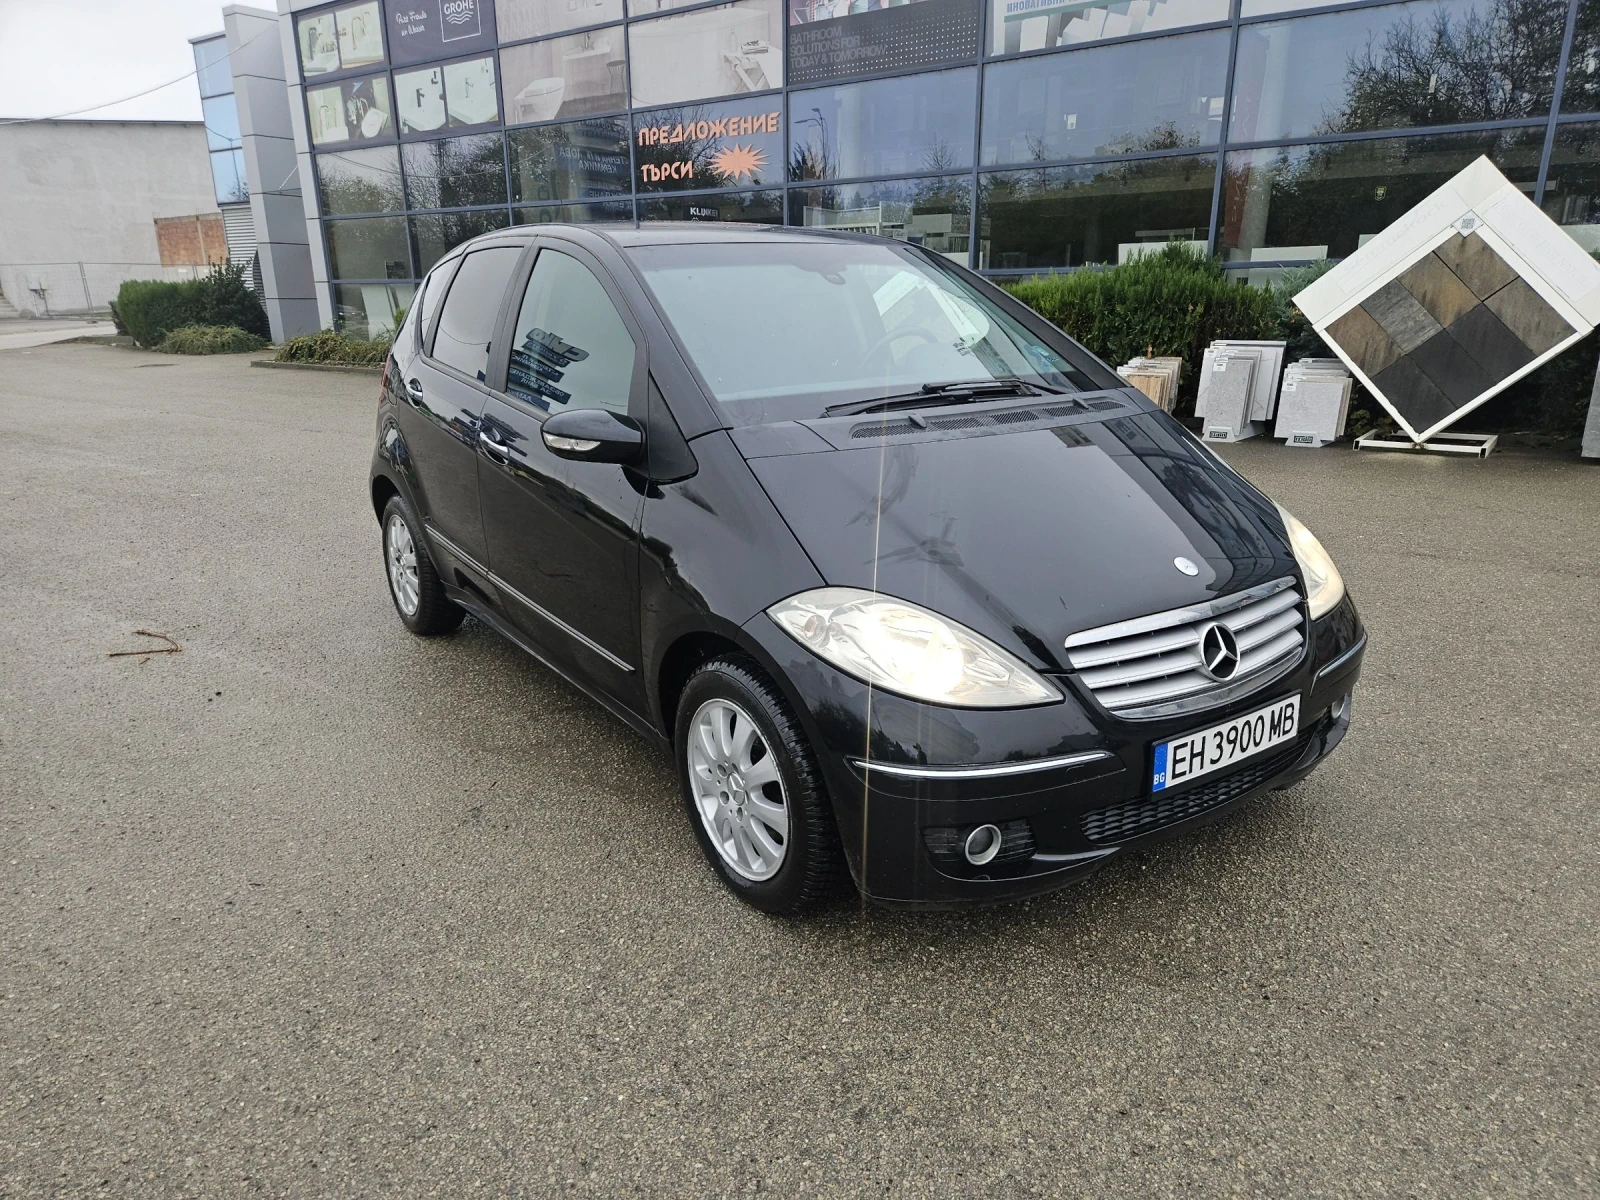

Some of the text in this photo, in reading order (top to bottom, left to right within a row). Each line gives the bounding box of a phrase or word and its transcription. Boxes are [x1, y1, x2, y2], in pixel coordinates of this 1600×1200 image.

[444, 0, 474, 15] GROHE
[790, 26, 842, 44] BATHROOM
[790, 35, 861, 57] SOLUTIONS FOR
[791, 44, 886, 69] TODAY & TOMORROW
[638, 111, 781, 146] ПРЕДЛОЖЕНИЕ
[640, 160, 693, 183] ТЪРСИ
[1171, 702, 1295, 780] EH 3900 MB
[1153, 772, 1166, 785] BG
